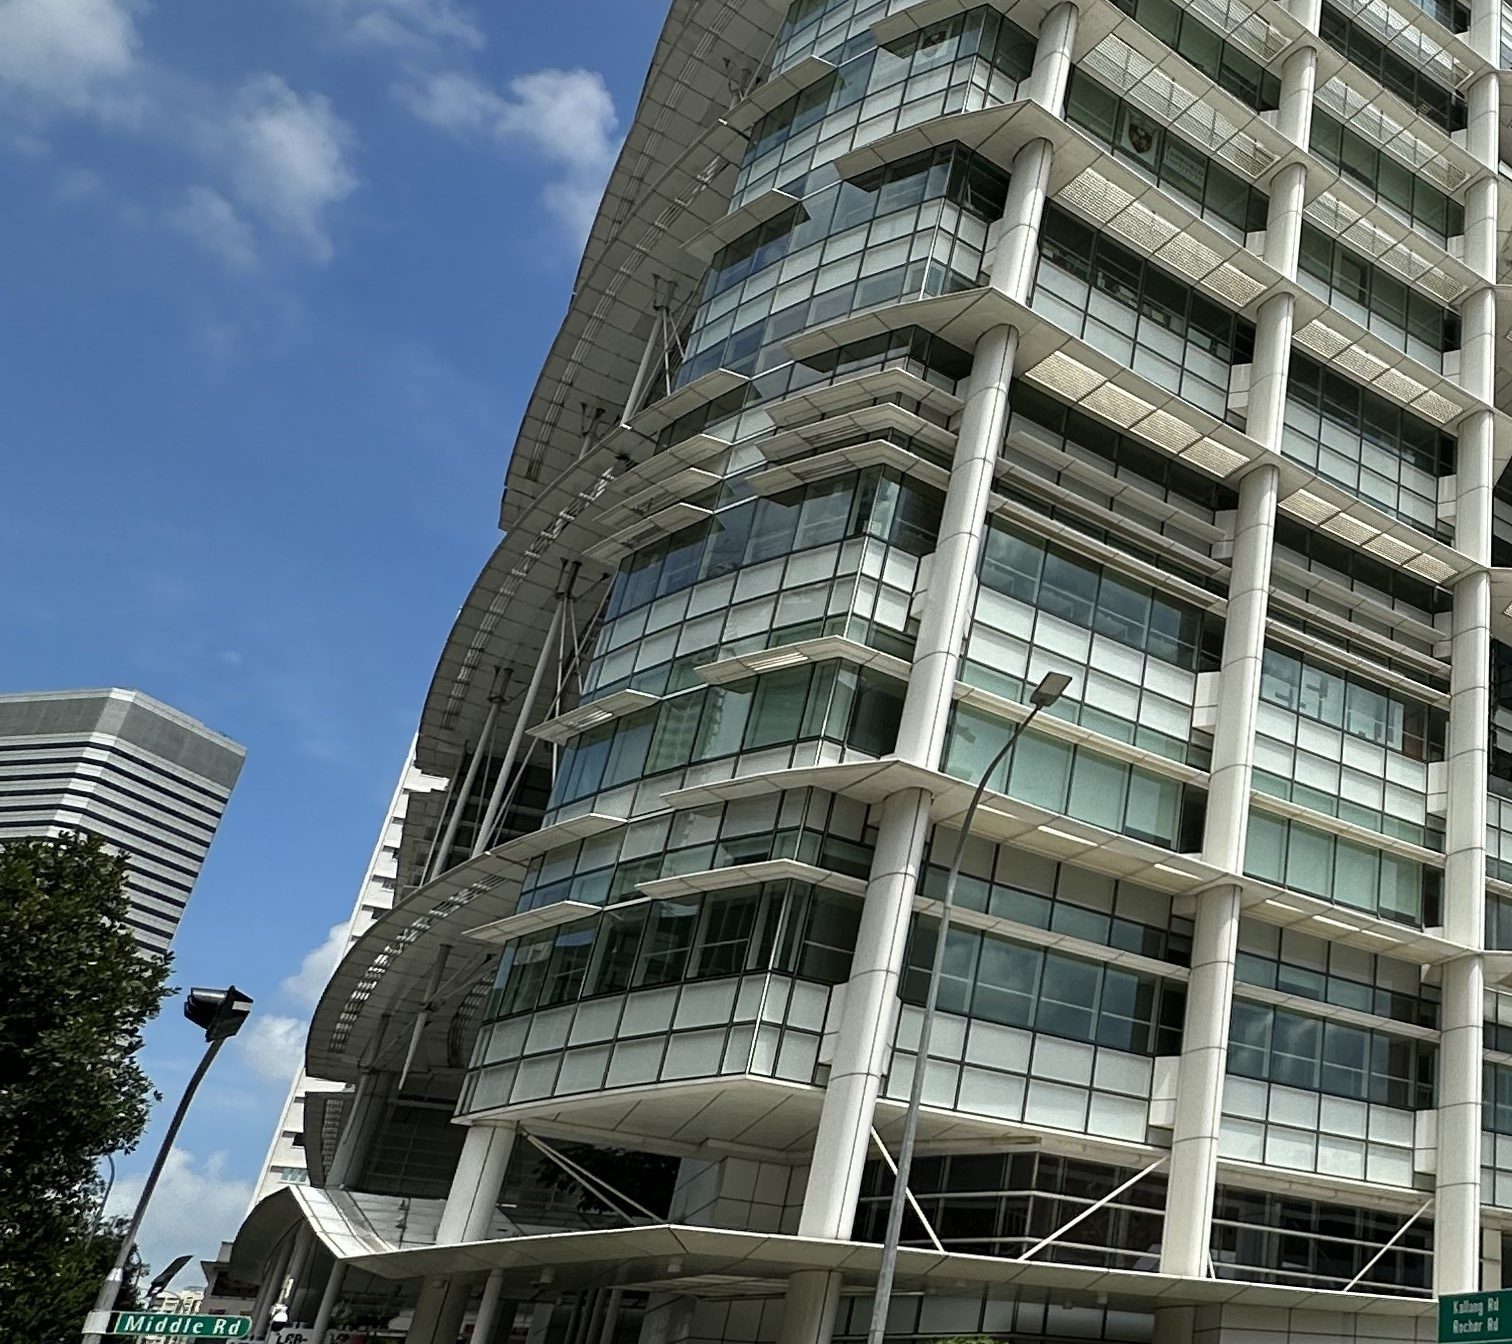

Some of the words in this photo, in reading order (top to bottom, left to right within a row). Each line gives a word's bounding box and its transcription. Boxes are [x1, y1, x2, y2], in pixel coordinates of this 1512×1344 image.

[1487, 1297, 1499, 1312] Rd
[123, 1315, 204, 1334] Middle
[212, 1317, 242, 1335] Rd
[1487, 1317, 1499, 1332] Rd
